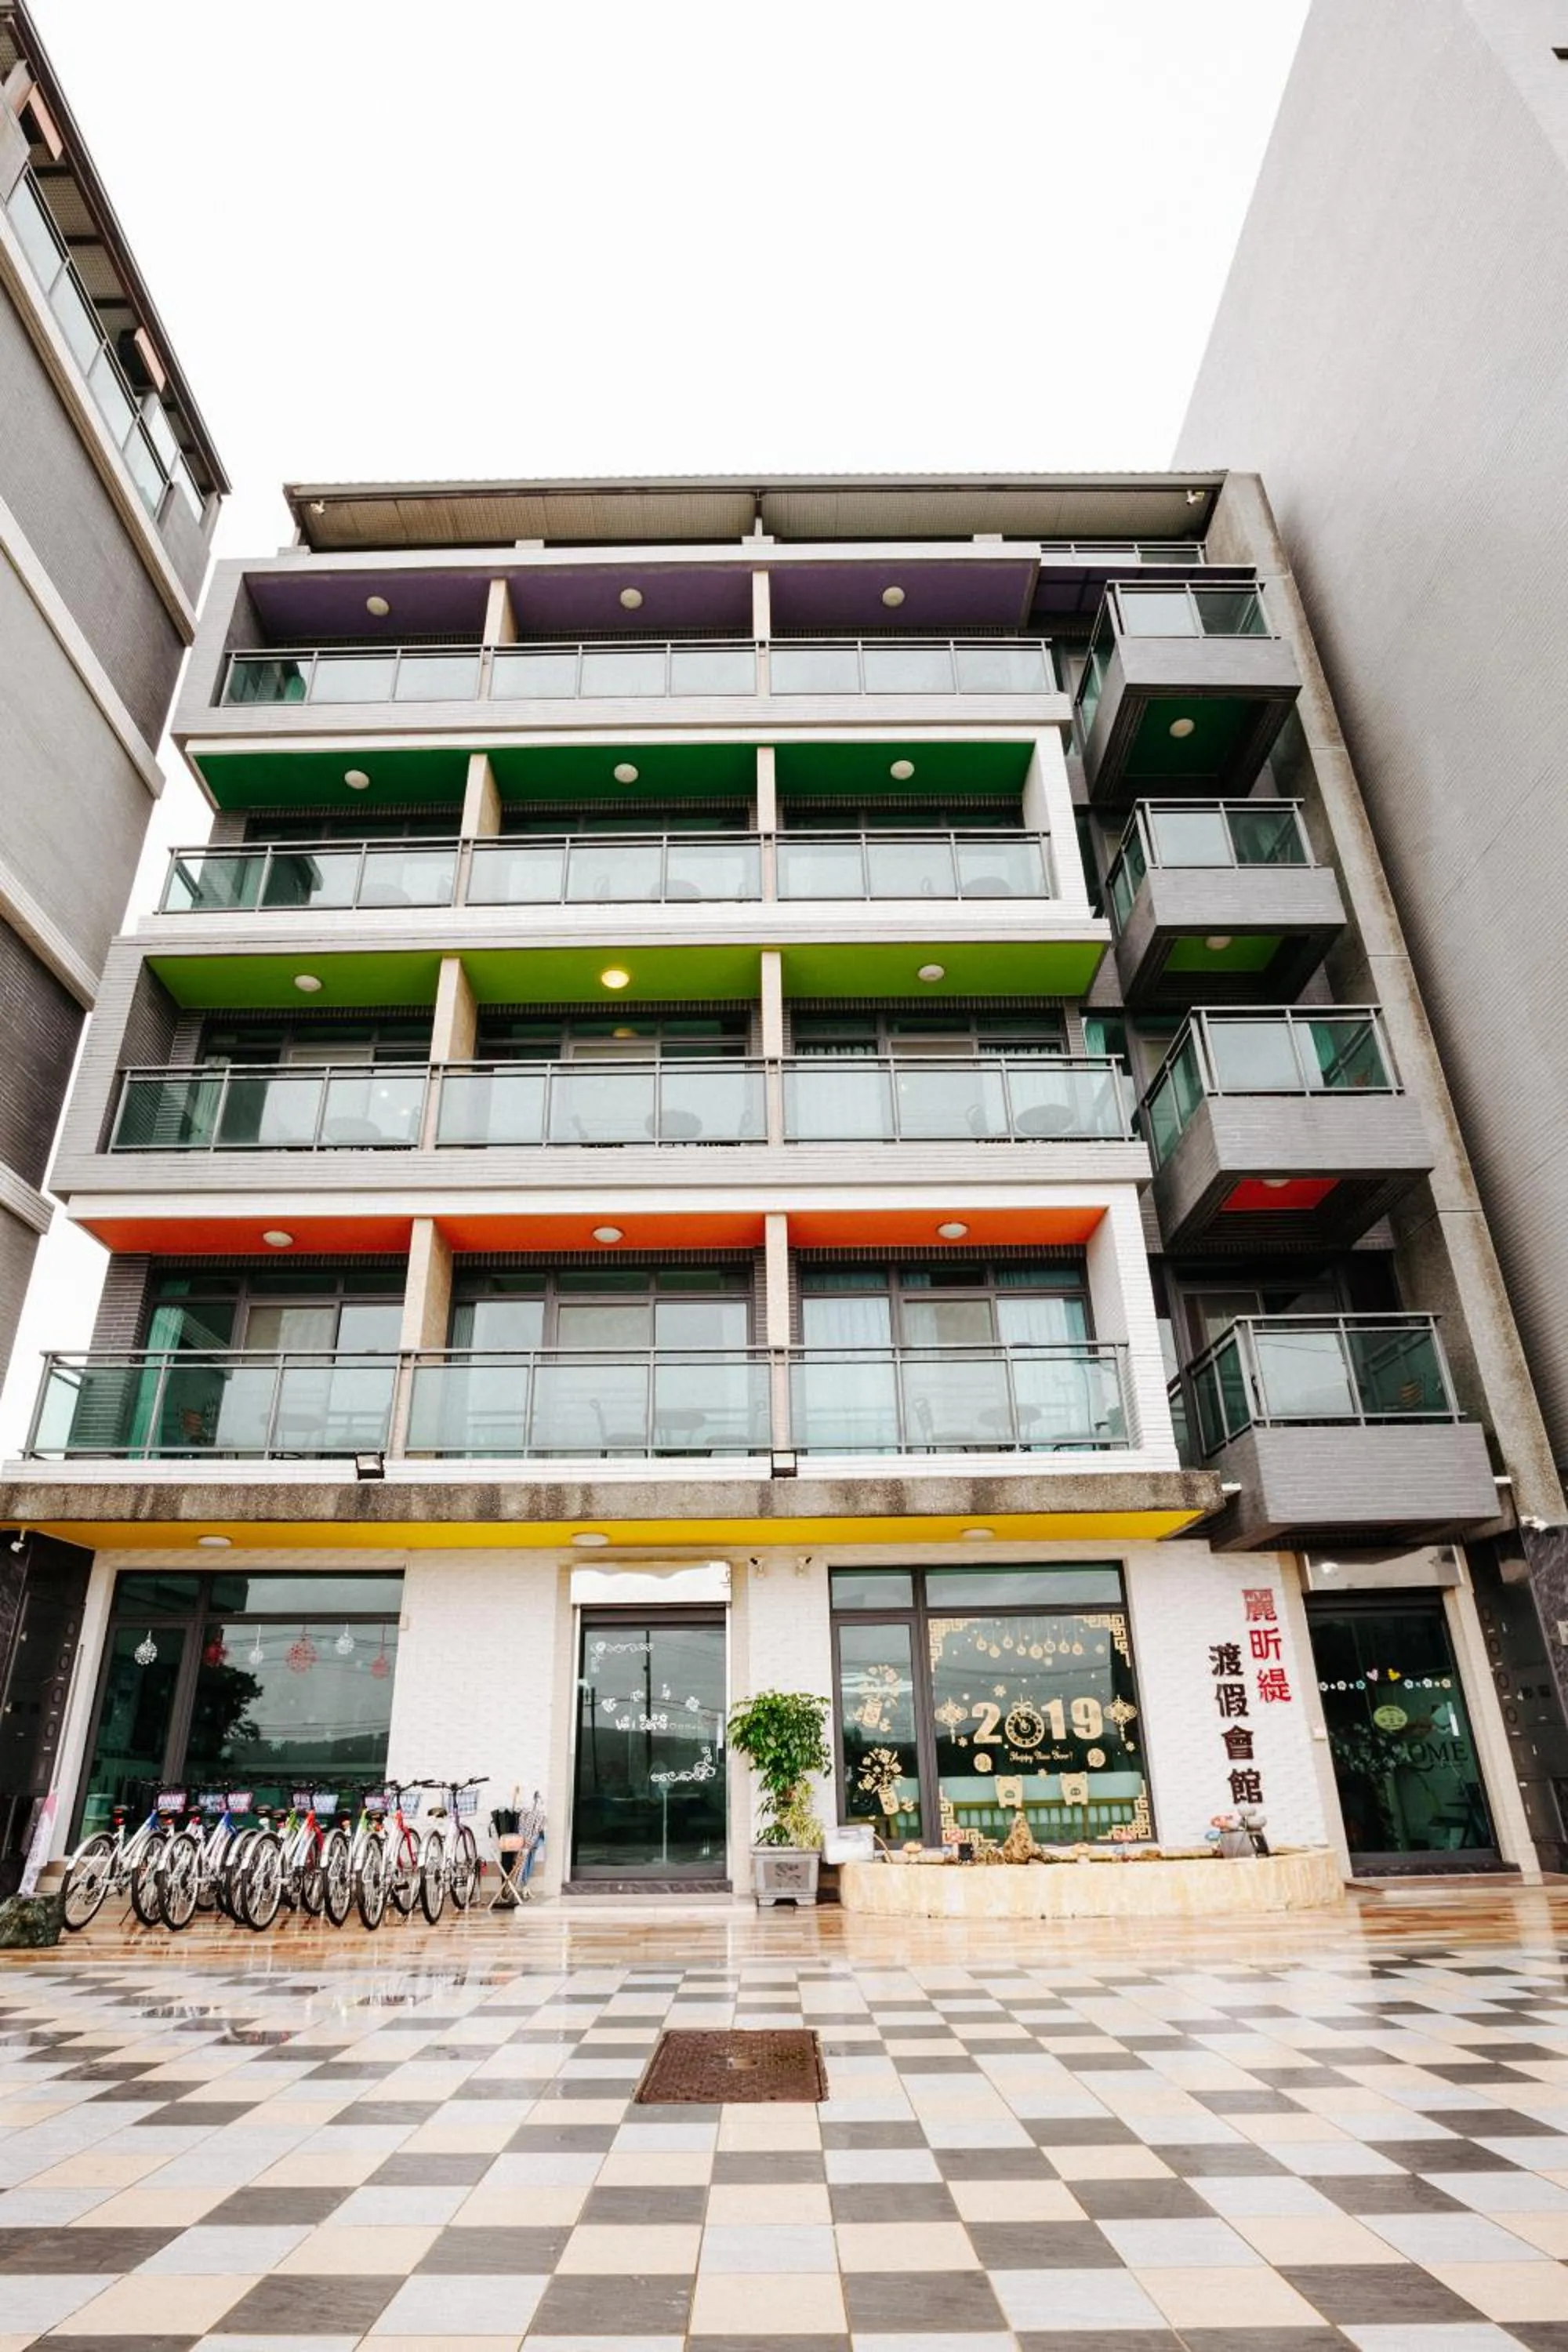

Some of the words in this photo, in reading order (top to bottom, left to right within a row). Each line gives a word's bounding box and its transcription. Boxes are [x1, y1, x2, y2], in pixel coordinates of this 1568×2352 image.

[1241, 1588, 1292, 1703] 麗昕緹
[1208, 1642, 1264, 1805] 渡假會館
